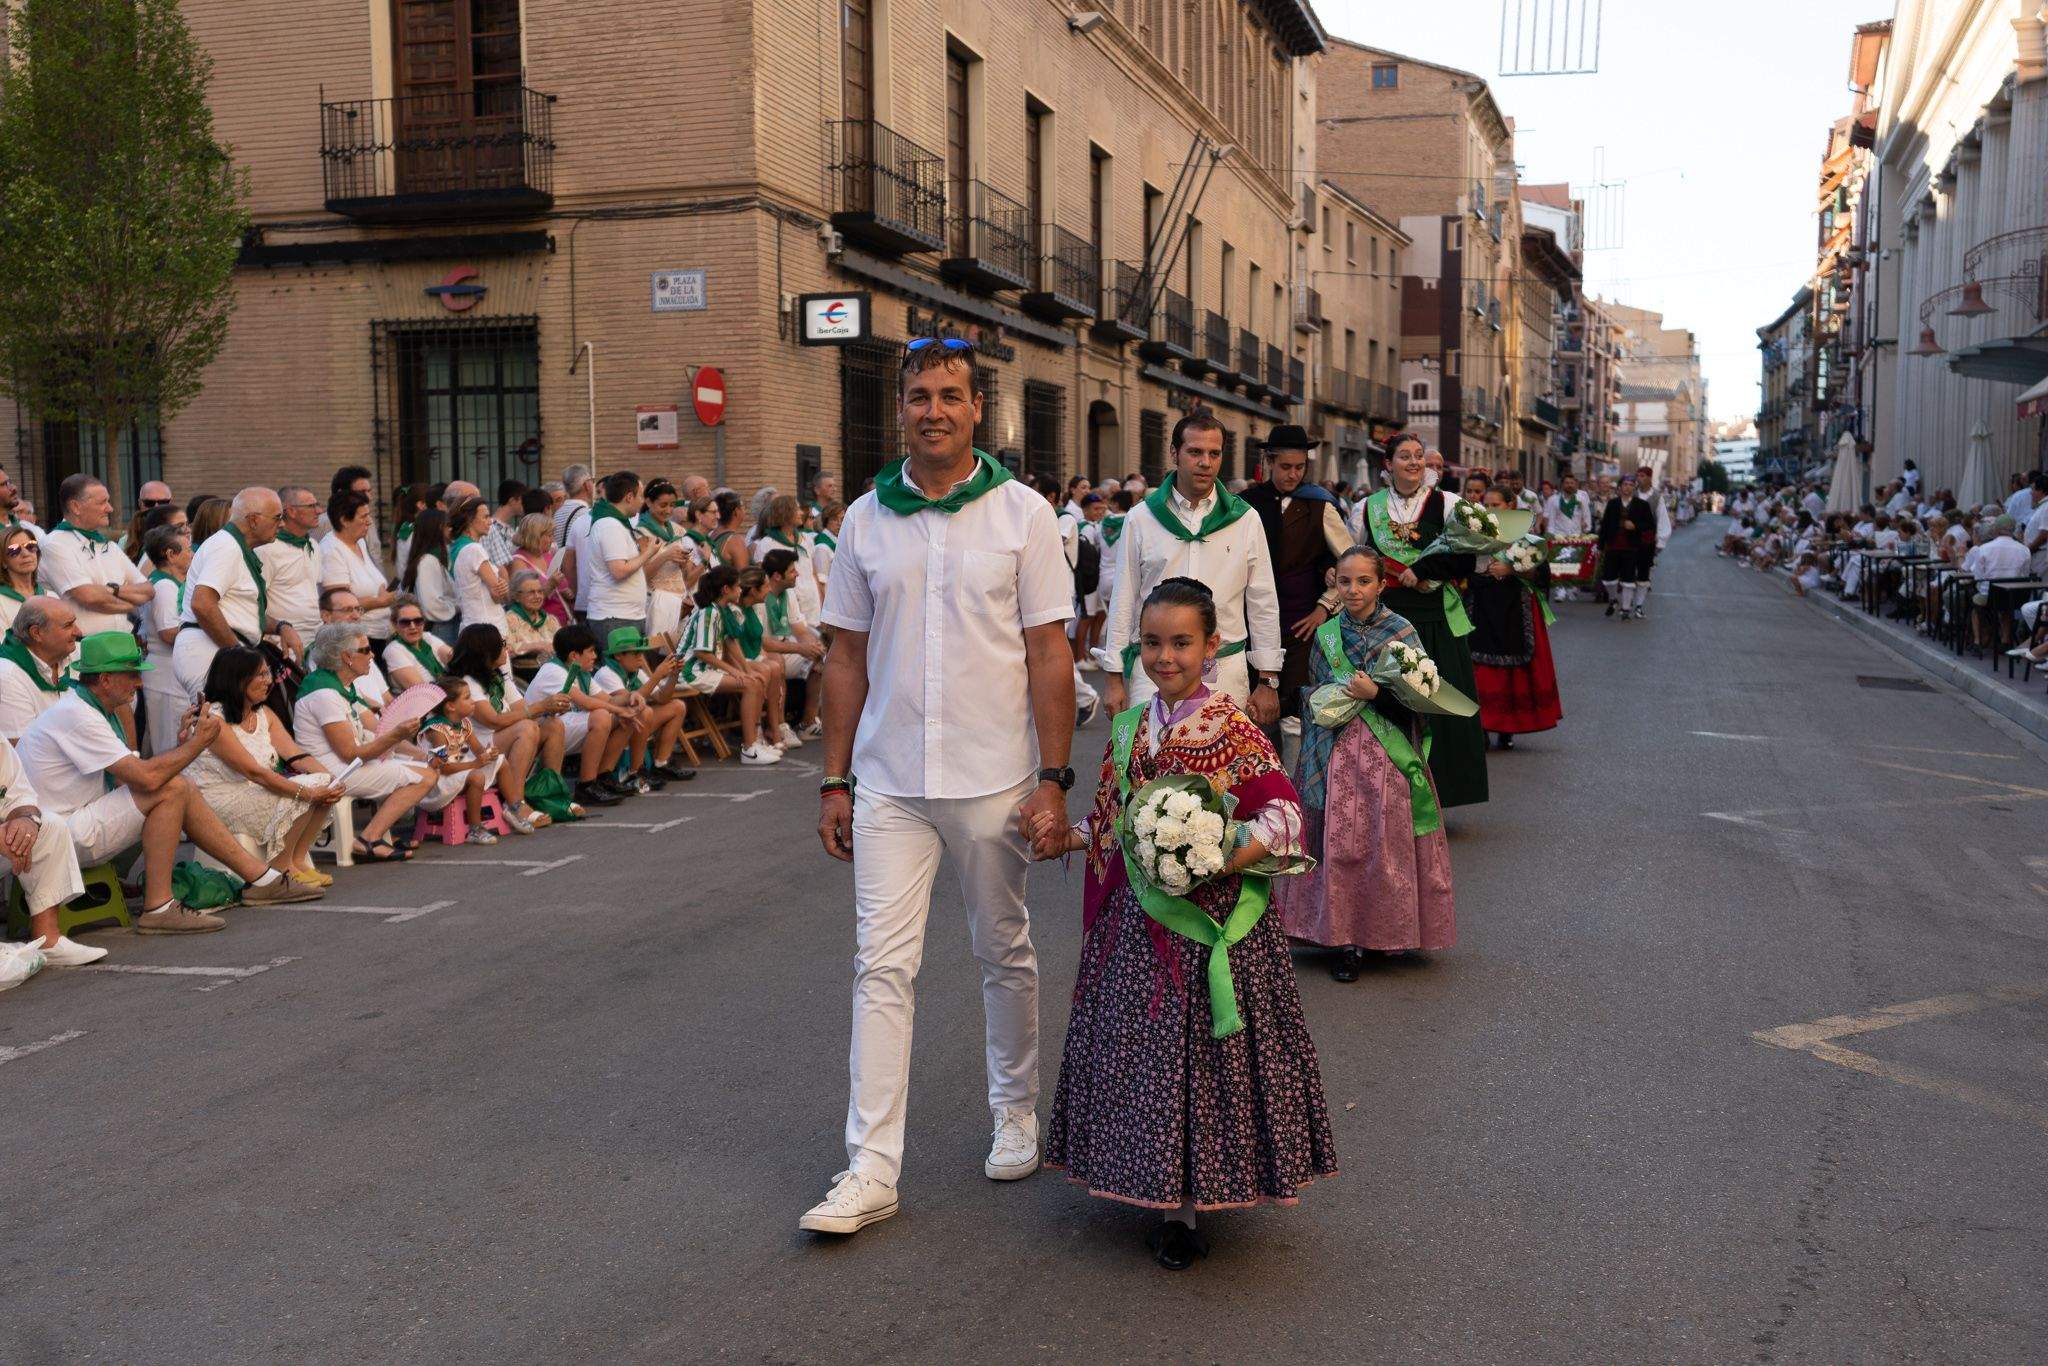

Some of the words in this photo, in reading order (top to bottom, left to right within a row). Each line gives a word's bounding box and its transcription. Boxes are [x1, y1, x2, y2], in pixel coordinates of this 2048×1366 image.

[673, 276, 696, 285] PLAZA
[670, 286, 681, 295] DE
[684, 285, 695, 295] LA
